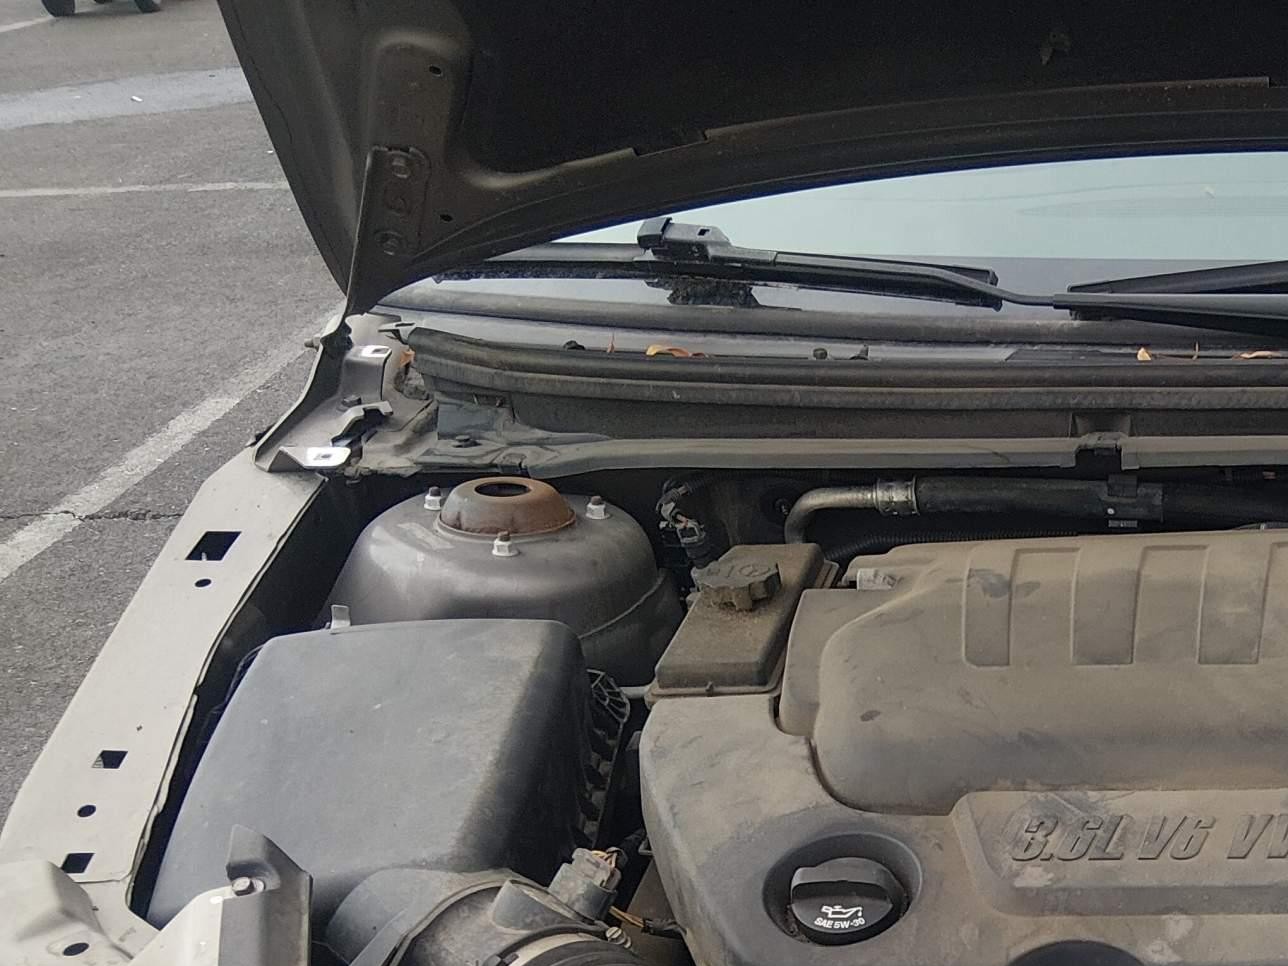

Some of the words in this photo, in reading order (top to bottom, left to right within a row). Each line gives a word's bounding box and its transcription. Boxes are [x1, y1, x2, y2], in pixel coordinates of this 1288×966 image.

[1011, 814, 1131, 861] 3.6L
[1137, 814, 1216, 860] V6
[814, 917, 833, 929] SAE
[833, 917, 866, 929] 5W-30
